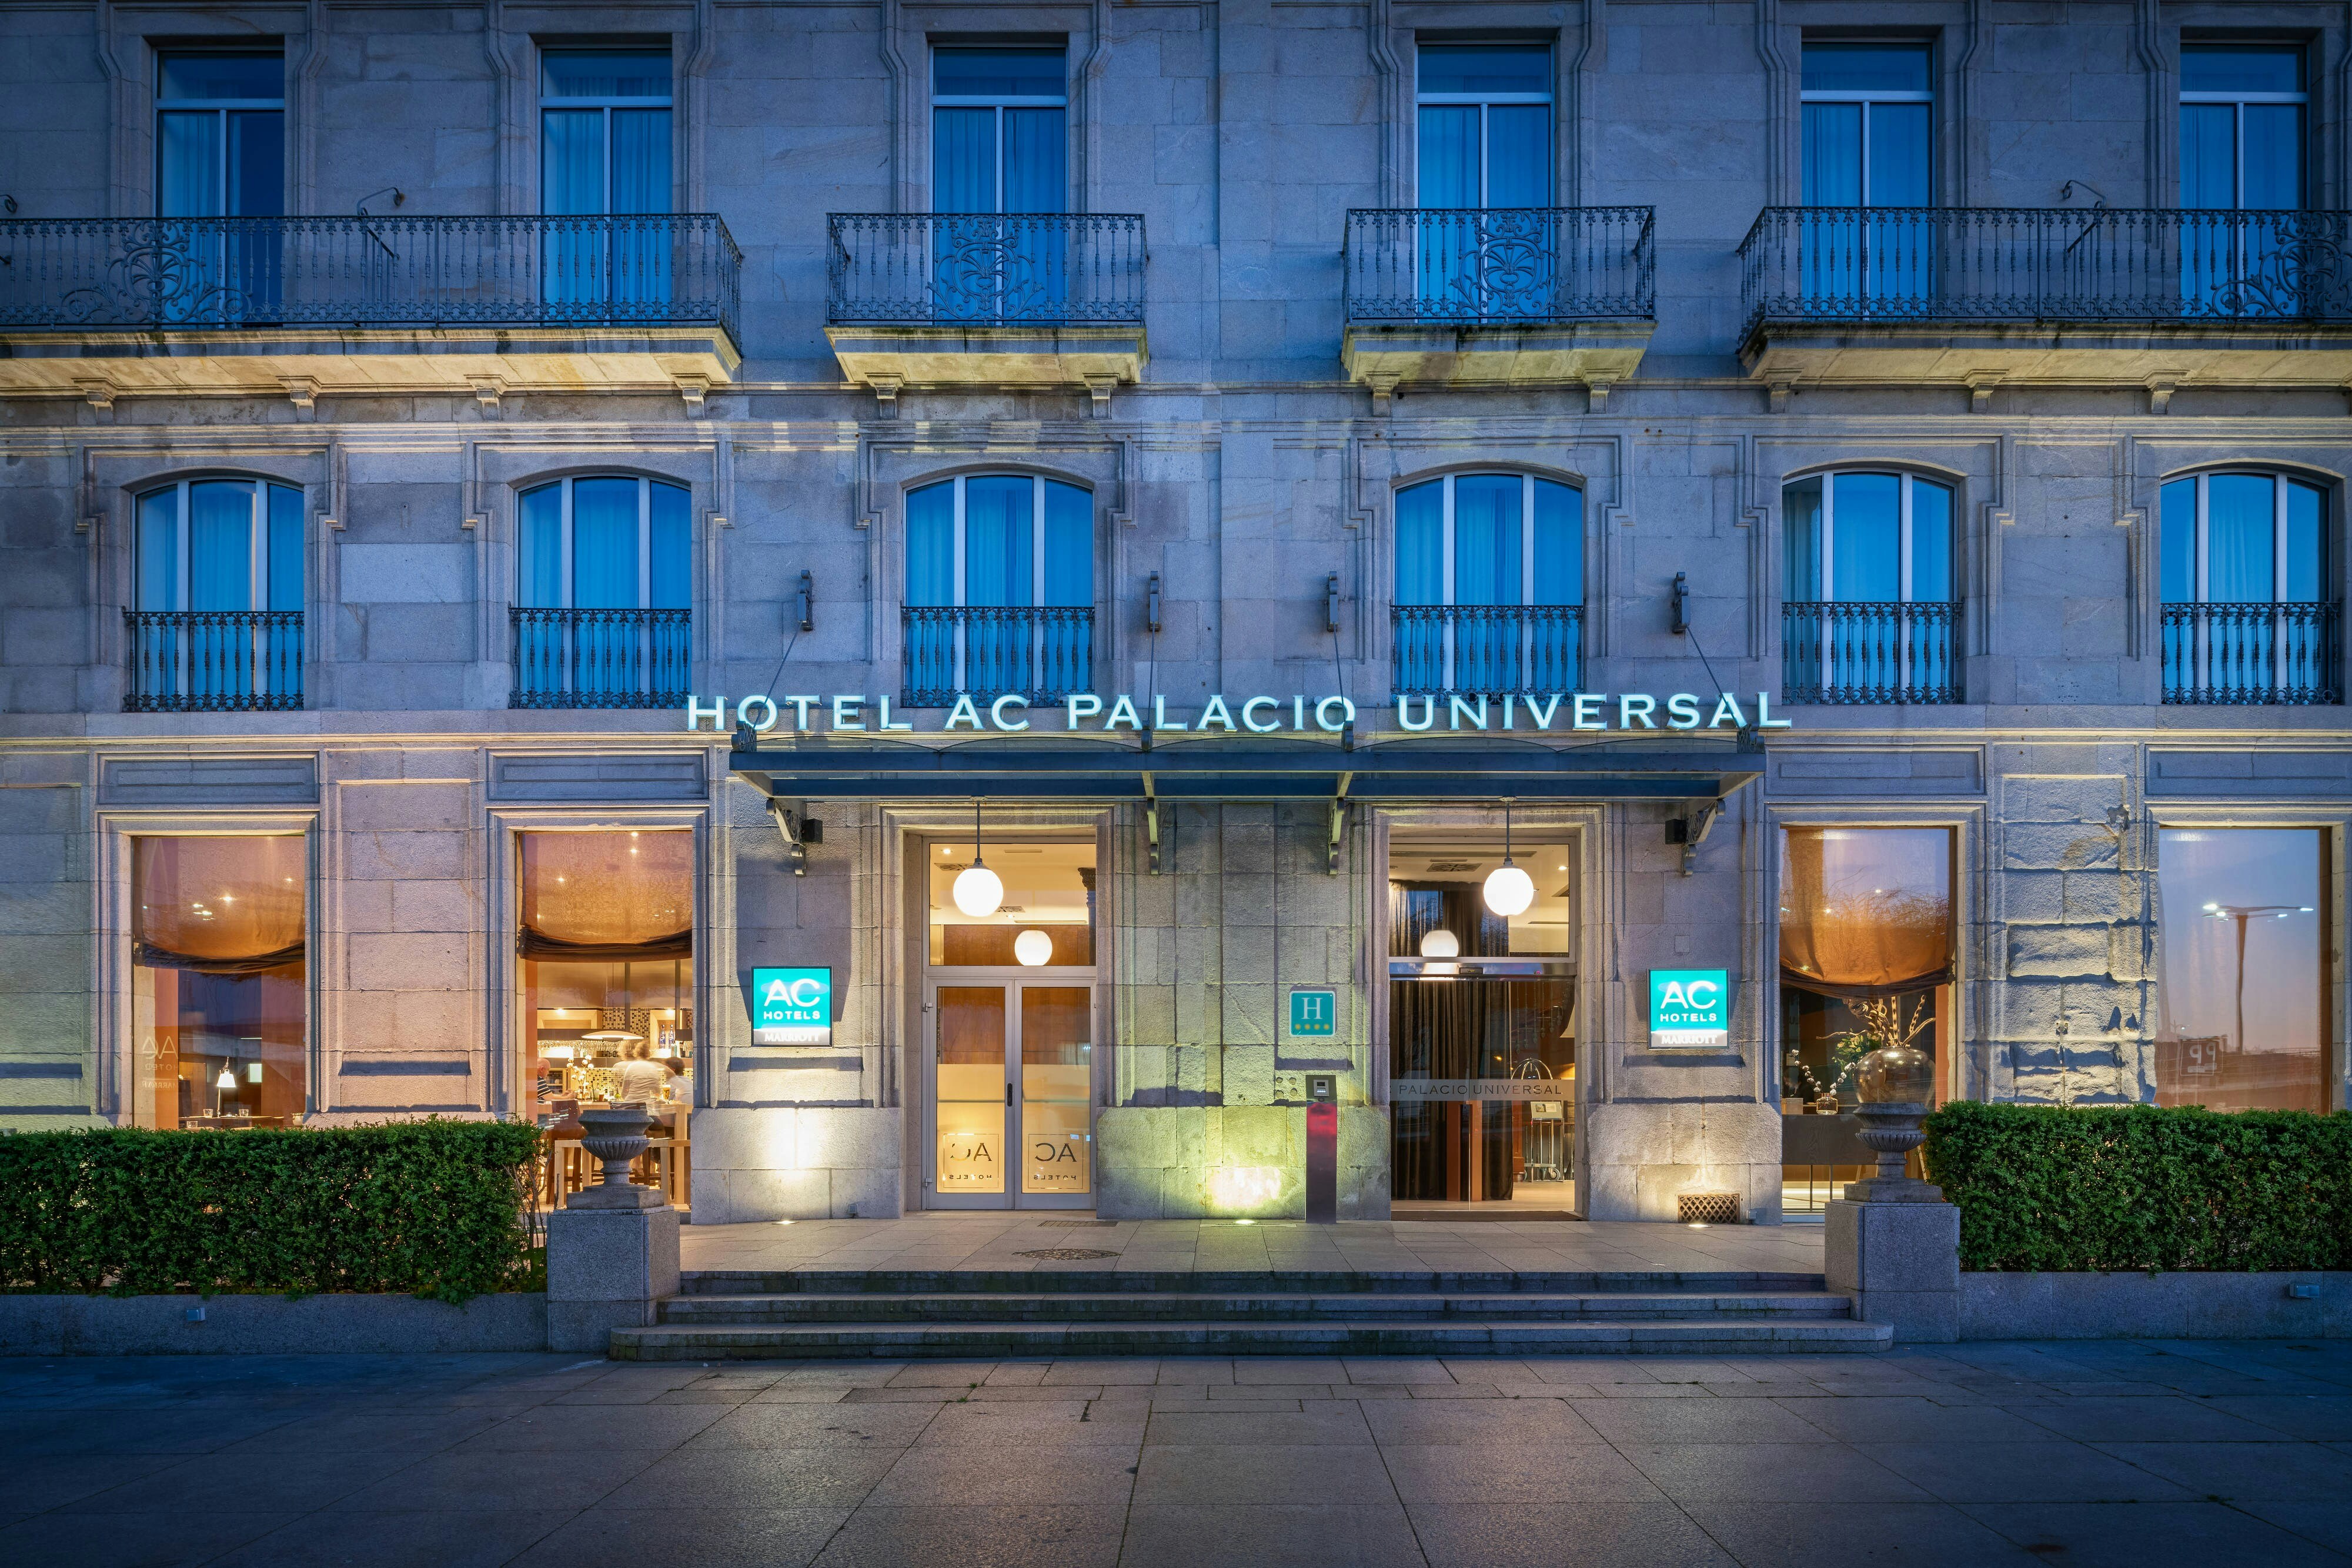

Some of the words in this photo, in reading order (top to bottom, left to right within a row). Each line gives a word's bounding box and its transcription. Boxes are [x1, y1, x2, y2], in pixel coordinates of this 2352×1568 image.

[687, 695, 913, 732] HOTEL
[943, 694, 1030, 731] AC
[1067, 694, 1355, 732] PALACIO
[1398, 692, 1792, 731] UNIVERSAL
[764, 978, 820, 1007] AC
[1660, 980, 1717, 1009] AC
[763, 1011, 820, 1020] HOTELS
[1301, 997, 1323, 1019] H
[1660, 1013, 1717, 1022] HOTELS
[1661, 1035, 1718, 1044] MARRIOTT
[1399, 1085, 1468, 1095] PALACIO
[1473, 1085, 1562, 1095] UNIVERSAL
